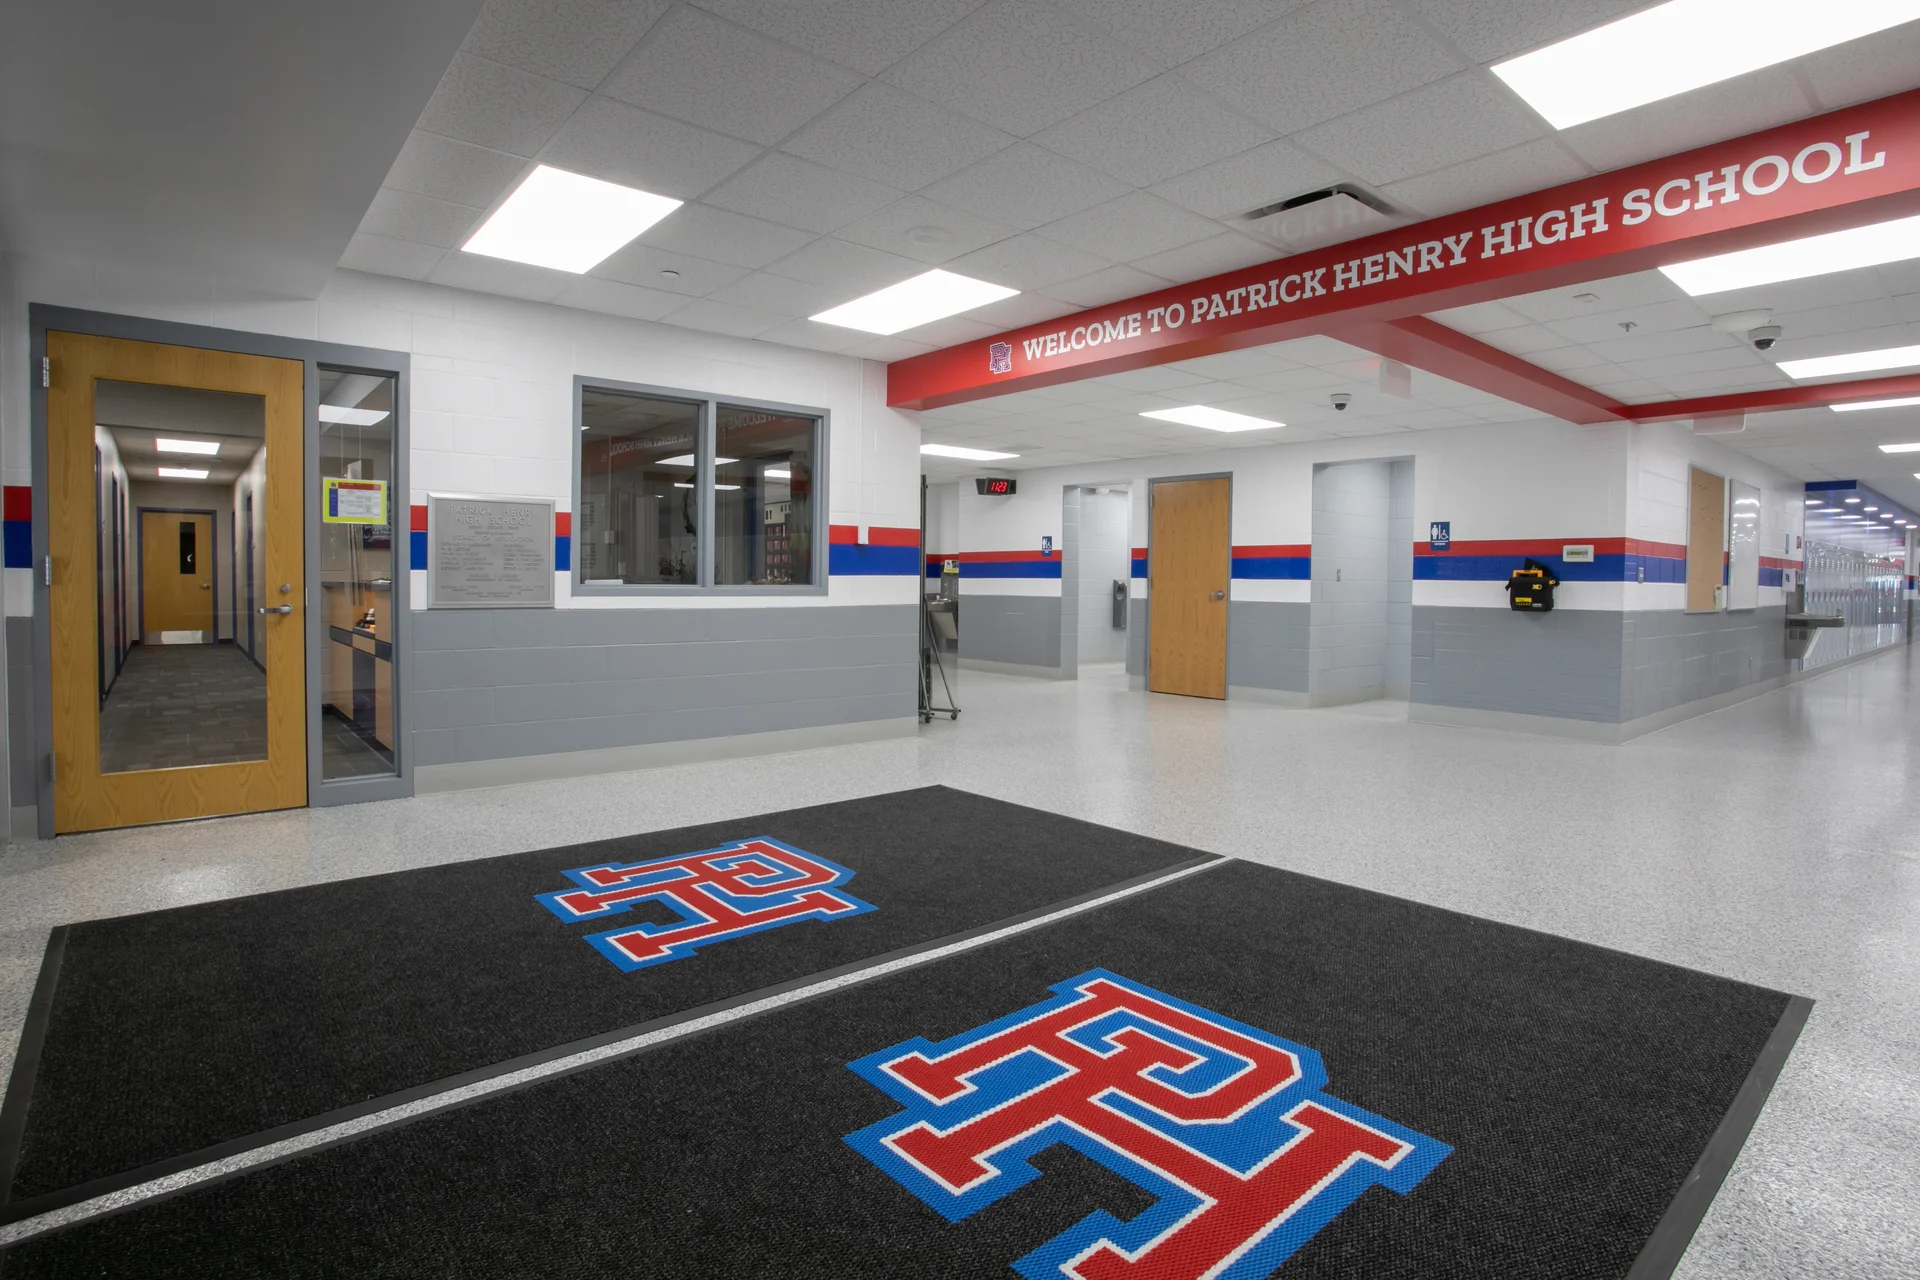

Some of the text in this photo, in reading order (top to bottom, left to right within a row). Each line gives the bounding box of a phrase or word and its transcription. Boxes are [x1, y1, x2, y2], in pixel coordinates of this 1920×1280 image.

[1022, 130, 1887, 361] WELCOME TO PATRICK HENRY HIGH SCHOOL
[449, 505, 537, 517] PATRICK HENRY
[455, 515, 532, 527] HIGH SCHOOL
